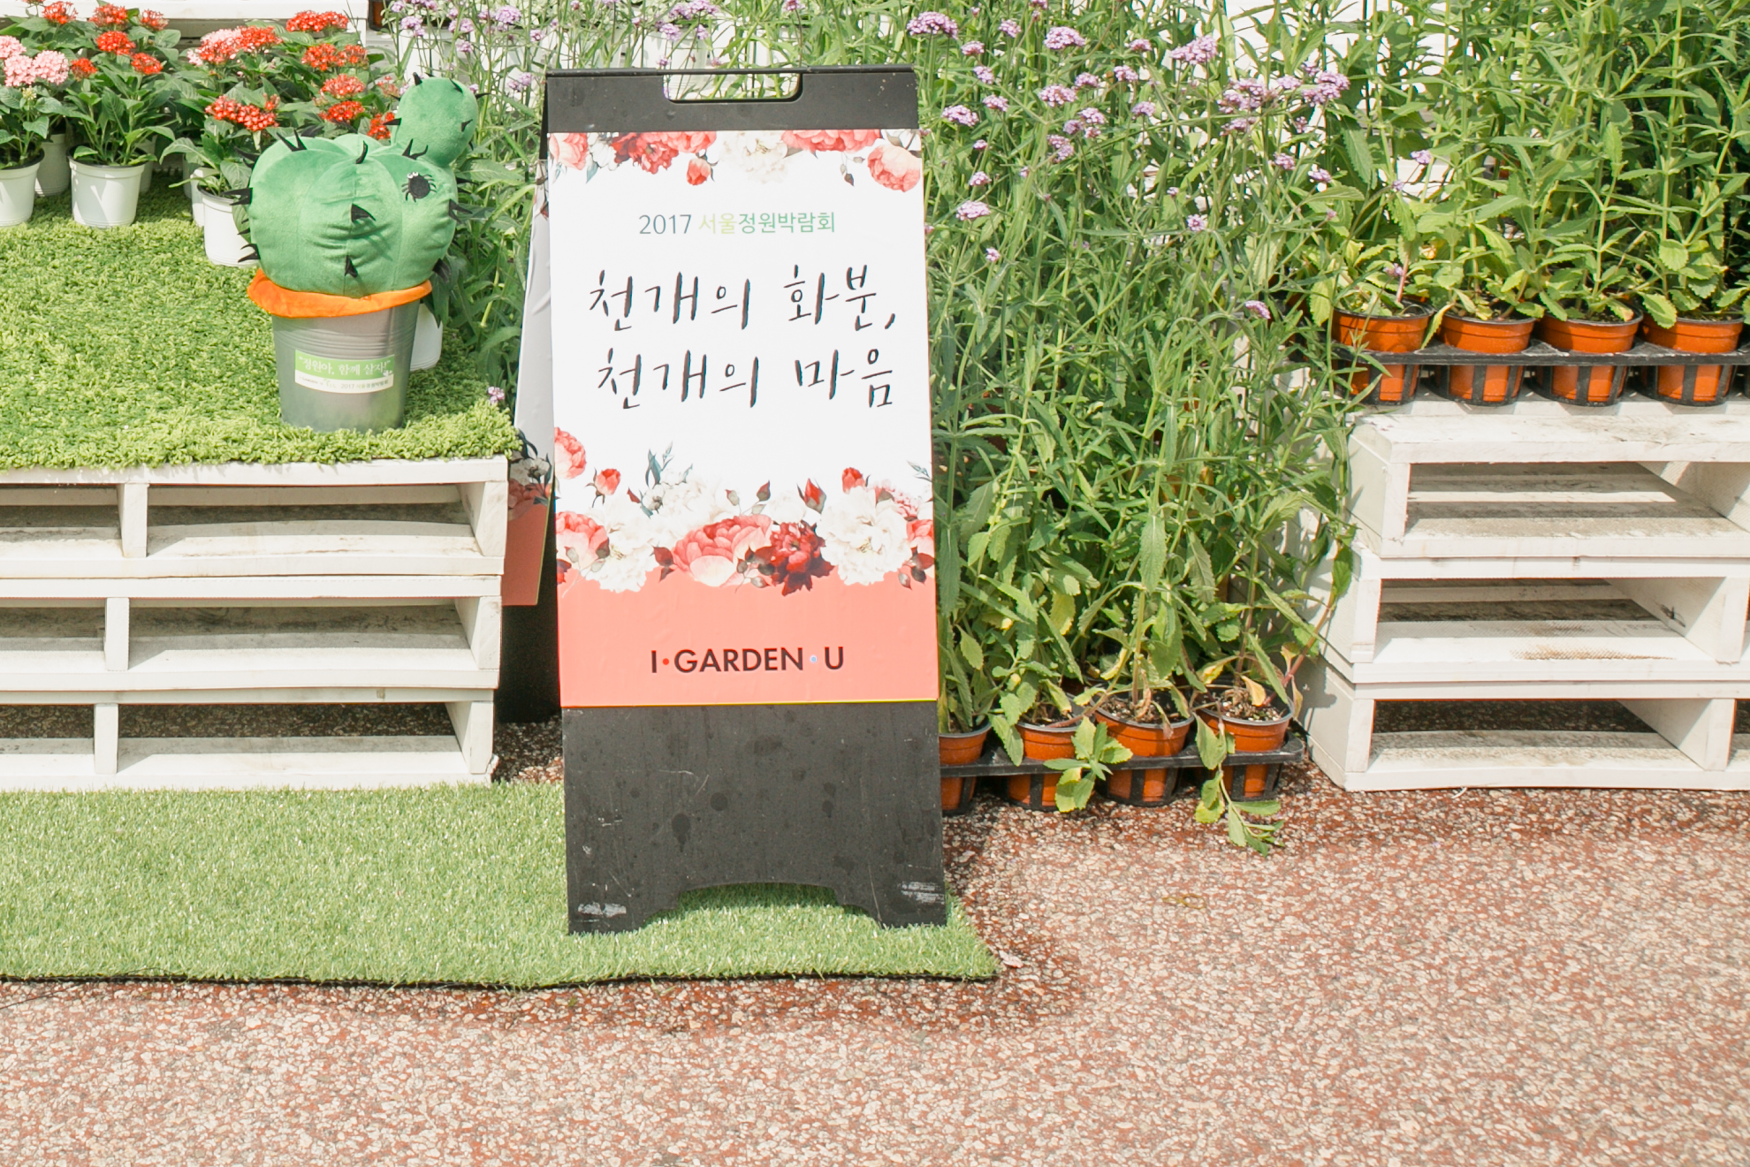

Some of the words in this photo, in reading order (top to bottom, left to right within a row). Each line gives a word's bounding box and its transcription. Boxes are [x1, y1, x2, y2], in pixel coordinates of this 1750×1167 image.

[639, 214, 692, 235] 2017
[699, 211, 836, 235] 서울정원박람회
[588, 270, 751, 332] 천개의
[783, 264, 896, 332] 화분,
[338, 363, 361, 376] 함께
[596, 345, 760, 410] 천개의
[793, 348, 893, 409] 마음
